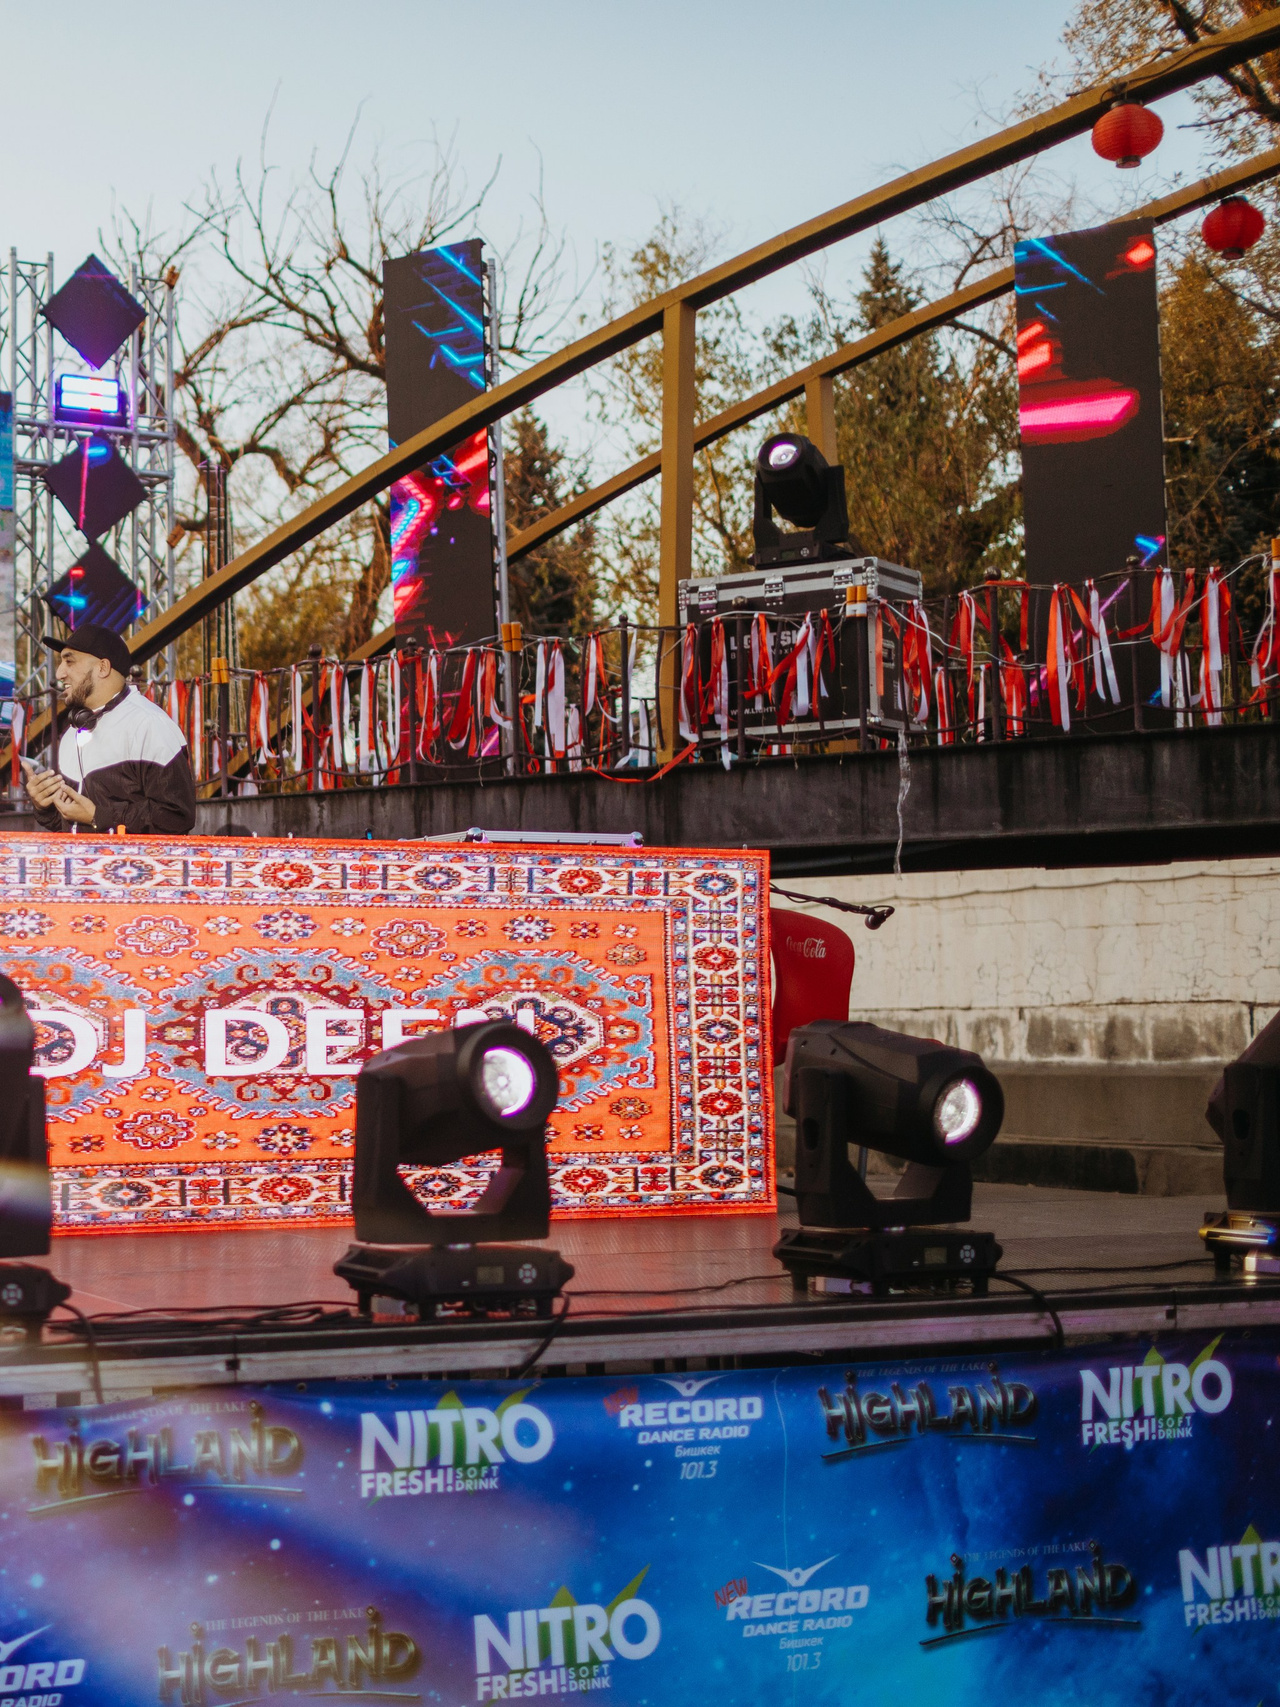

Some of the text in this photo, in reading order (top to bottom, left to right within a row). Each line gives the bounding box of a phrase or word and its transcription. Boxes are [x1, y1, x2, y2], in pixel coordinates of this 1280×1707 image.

[26, 1008, 146, 1078] DJ
[924, 1364, 938, 1374] OF
[940, 1363, 959, 1373] THE
[1080, 1360, 1233, 1421] NITRO
[619, 1397, 763, 1428] RECORD
[818, 1376, 1036, 1443] HIGHLAND
[1158, 1416, 1192, 1428] SOFT
[360, 1403, 554, 1471] NITRO
[638, 1425, 750, 1445] DANCE RADIO
[1082, 1418, 1157, 1446] FRESH!
[1158, 1427, 1193, 1440] DRINK
[31, 1417, 303, 1495] HIGHLAND
[675, 1445, 721, 1458] Бишкек
[361, 1467, 454, 1498] FRESH!
[455, 1465, 499, 1479] SOFT
[455, 1477, 499, 1491] DRINK
[680, 1460, 718, 1480] 101.3
[1027, 1546, 1040, 1557] OF
[1043, 1544, 1060, 1554] THE
[1062, 1541, 1088, 1552] LAKE
[1178, 1542, 1280, 1603] NITR
[714, 1576, 748, 1611] NEW
[726, 1585, 870, 1621] RECORD
[926, 1556, 1136, 1632] HIGHLAND
[205, 1607, 365, 1631] THE LEGENDS OF THE LAKE
[742, 1615, 853, 1638] DANCE RADIO
[1183, 1598, 1258, 1628] FRESH!
[473, 1598, 661, 1675] NITRO
[779, 1636, 825, 1650] Бишкек
[158, 1624, 418, 1706] HIGHLAND
[568, 1664, 610, 1680] SOFT
[786, 1652, 822, 1672] 101.3
[475, 1667, 567, 1702] FRESH!
[568, 1676, 611, 1692] DRINK
